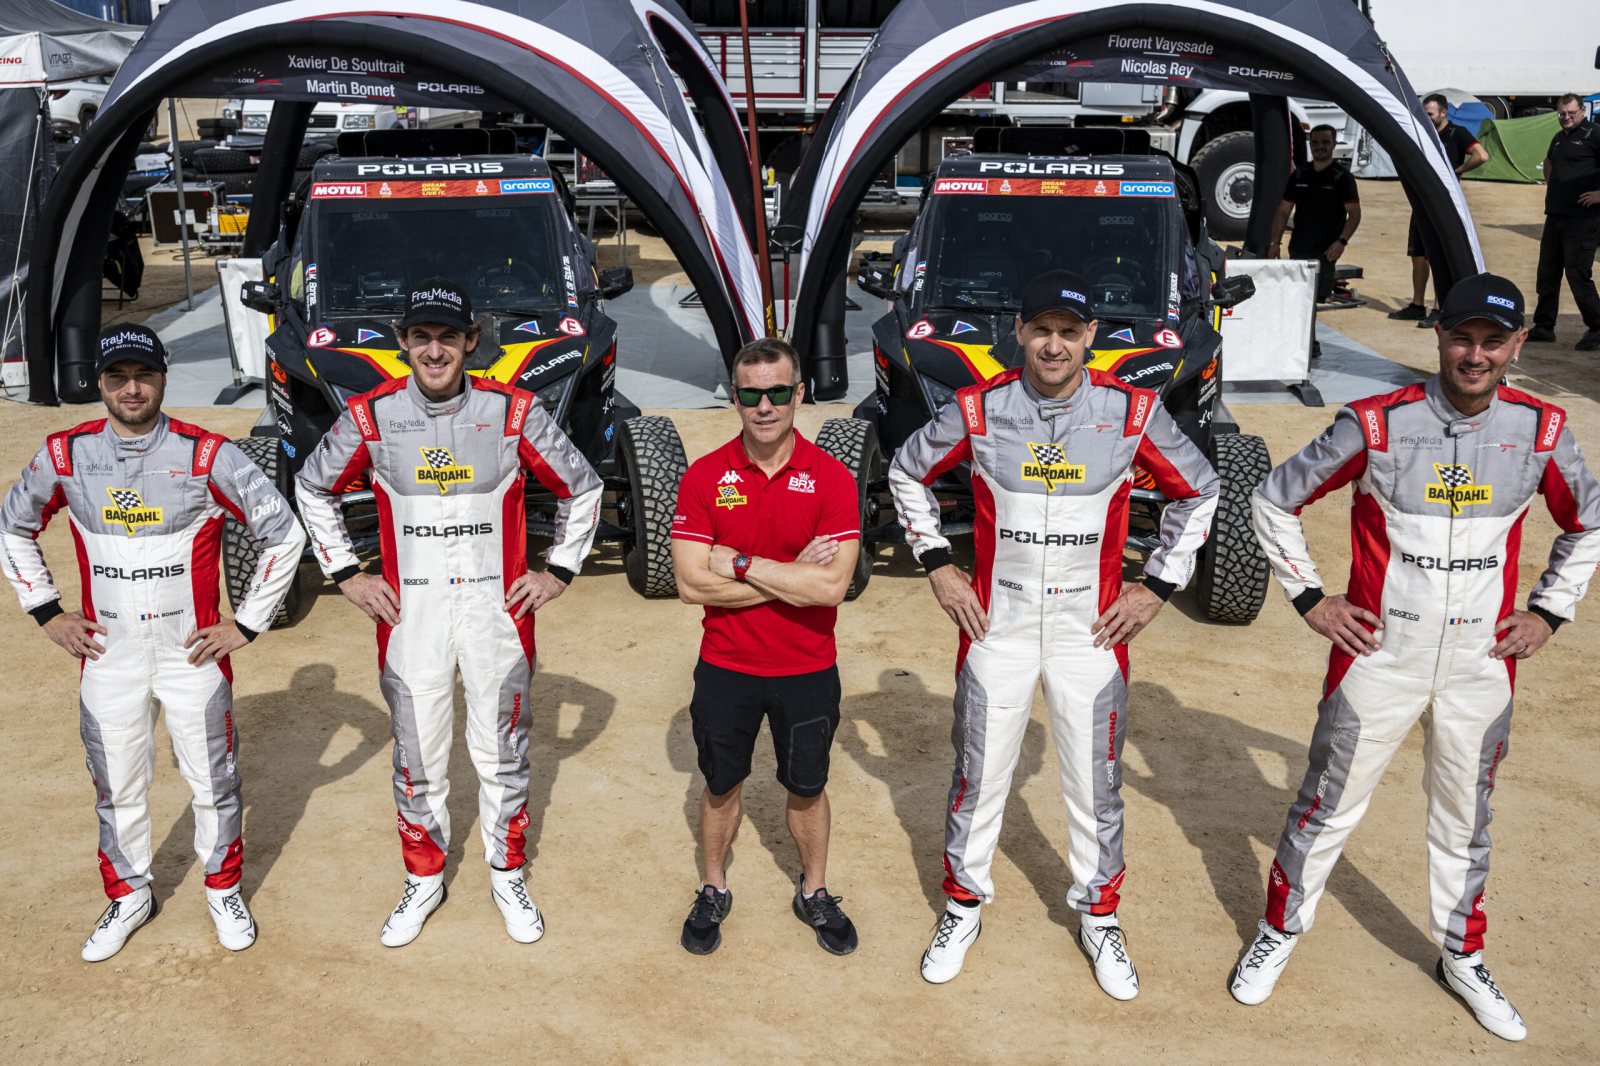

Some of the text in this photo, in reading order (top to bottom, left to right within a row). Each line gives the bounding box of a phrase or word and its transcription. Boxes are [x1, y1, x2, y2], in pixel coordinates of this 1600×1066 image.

[1108, 34, 1214, 55] Florent Vayssade
[287, 54, 405, 74] Xavier De Soultrait
[1120, 59, 1194, 79] Nicolas Rey
[1228, 66, 1295, 81] POLARIS
[306, 79, 396, 98] Martin Bonnet
[417, 82, 485, 95] POLARIS
[358, 162, 504, 176] POLARIS
[979, 162, 1125, 176] POLARIS
[313, 185, 364, 196] MOTUL
[503, 180, 551, 191] aramco
[937, 182, 985, 191] MOTUL
[1122, 184, 1172, 194] aramco
[411, 287, 463, 306] FrayMédia
[1061, 289, 1086, 304] sparco
[1487, 295, 1515, 310] sparco
[566, 320, 579, 333] E
[914, 323, 927, 336] E
[101, 331, 154, 350] FrayMédia
[315, 329, 328, 344] E
[1162, 331, 1176, 345] E
[520, 349, 583, 382] POLARIS
[1119, 362, 1174, 384] OLARIS
[511, 398, 527, 430] sparco
[964, 394, 978, 428] sparco
[1132, 394, 1149, 428] sparco
[354, 404, 373, 437] sparco
[1365, 409, 1381, 446] sparco
[1542, 412, 1561, 447] sparco
[52, 437, 66, 470] sparco
[198, 438, 216, 468] sparco
[418, 468, 472, 481] BARDAHL
[1024, 466, 1082, 480] BARDAHL
[238, 475, 270, 498] PHILIPS
[788, 476, 817, 490] BRX
[717, 497, 746, 505] BARDAHL
[1428, 487, 1489, 502] BARDAHL
[251, 495, 281, 521] Dafy
[105, 509, 161, 524] BARDAHL
[403, 522, 493, 539] POLARIS
[1000, 528, 1099, 546] POLARIS
[1401, 552, 1499, 572] POLARIS
[93, 563, 185, 582] POLARIS
[403, 578, 429, 586] sparco
[1065, 585, 1092, 594] VAYSSADE
[161, 609, 185, 618] BONNET
[1388, 607, 1420, 622] sparco
[1107, 711, 1118, 761] RACING
